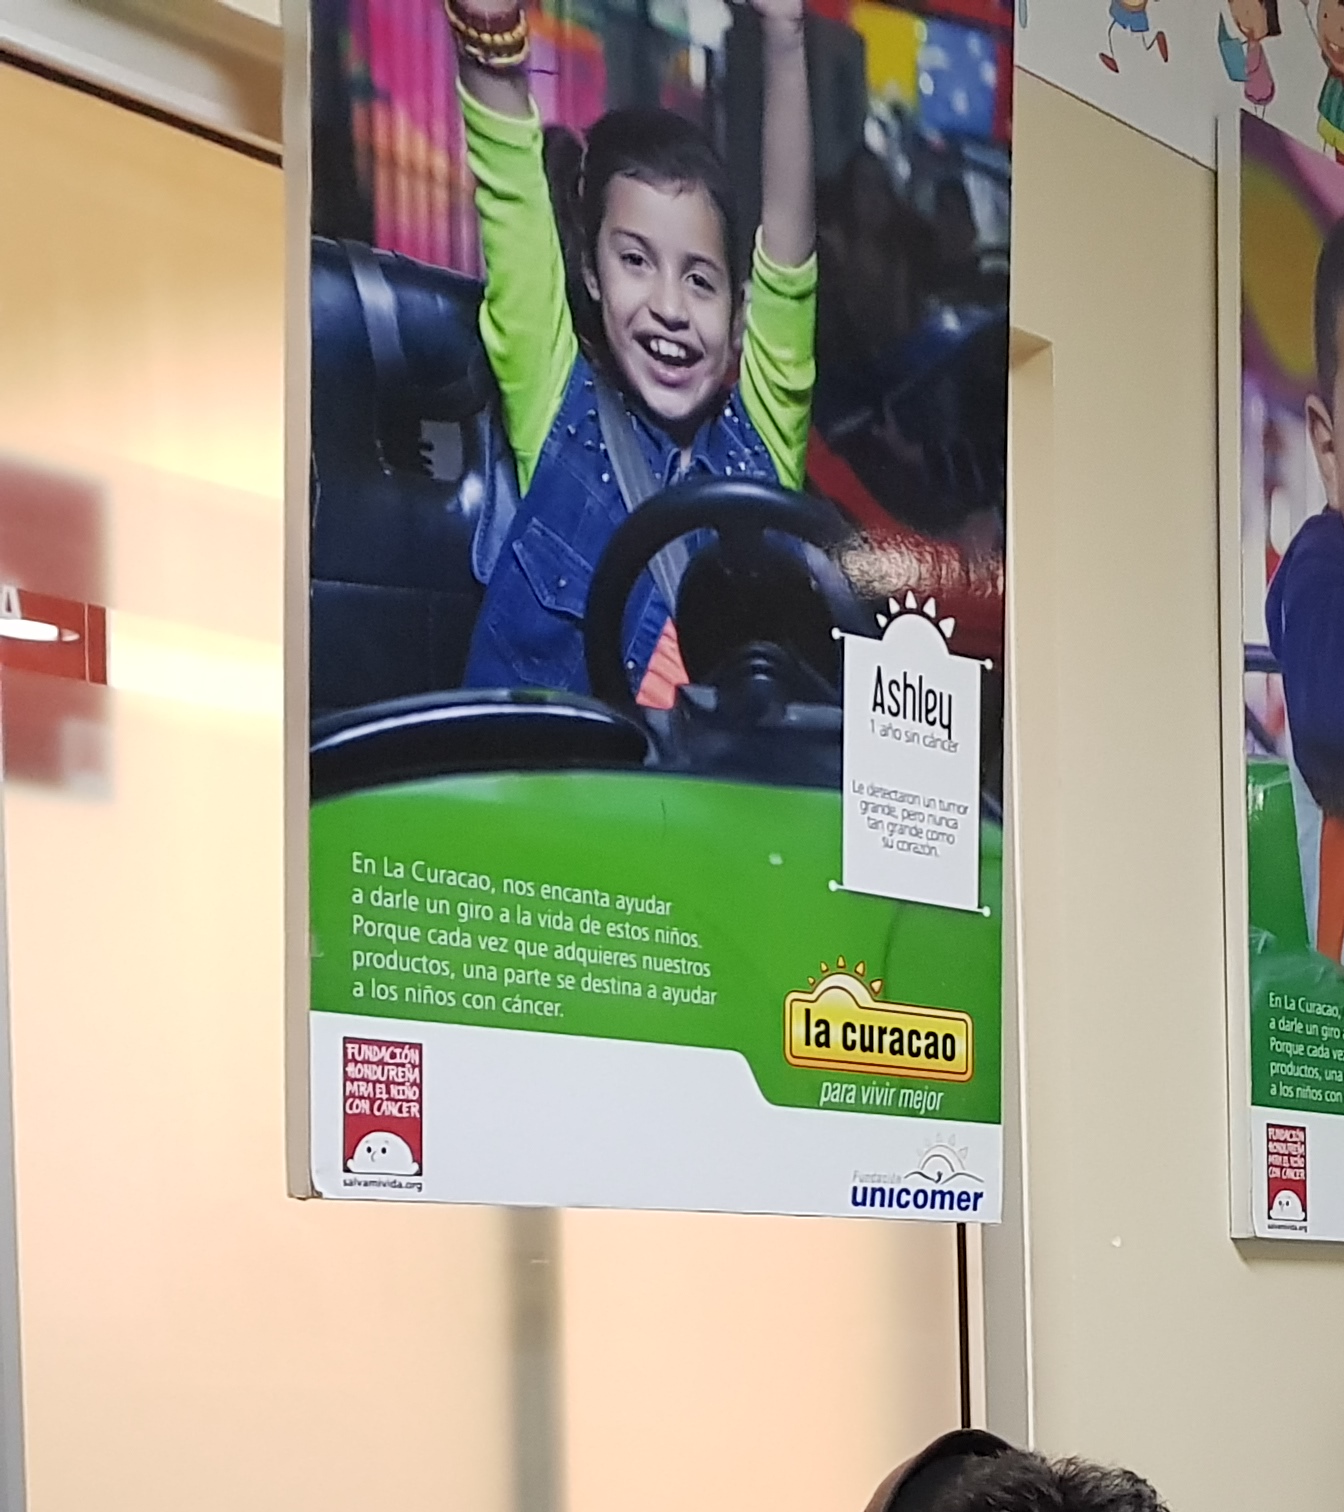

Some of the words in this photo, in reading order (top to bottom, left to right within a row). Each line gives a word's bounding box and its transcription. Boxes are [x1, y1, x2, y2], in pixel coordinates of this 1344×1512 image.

[872, 665, 952, 740] Ashley
[871, 719, 875, 734] 1
[880, 722, 901, 740] año
[905, 729, 919, 744] sin
[923, 733, 959, 753] cáncer
[352, 852, 375, 874] En
[384, 856, 404, 878] La
[412, 860, 496, 894] Curacao,
[503, 877, 534, 897] nos
[541, 881, 609, 907] encanta
[616, 892, 671, 917] ayudar
[352, 887, 363, 903] a
[371, 886, 419, 911] darle
[426, 899, 450, 914] un
[457, 898, 493, 922] giro
[500, 907, 510, 922] a
[517, 905, 532, 925] la
[538, 909, 574, 931] vida
[580, 916, 600, 935] de
[606, 922, 649, 942] estos
[655, 928, 702, 949] niños.
[352, 915, 420, 943] Porque
[428, 926, 471, 948] cada
[478, 934, 509, 952] vez
[515, 939, 548, 959] que
[554, 942, 637, 969] adquieres
[642, 954, 711, 978] nuestros
[352, 949, 455, 979] productos,
[463, 961, 497, 981] una
[504, 965, 550, 987] parte
[557, 974, 575, 989] se
[581, 973, 642, 997] destina
[648, 984, 657, 999] a
[662, 985, 717, 1006] ayudar
[352, 980, 363, 997] a
[371, 979, 398, 1001] los
[405, 985, 456, 1006] niños
[462, 991, 495, 1010] con
[502, 994, 564, 1018] cáncer.
[1270, 992, 1281, 1008] En
[1285, 995, 1295, 1011] La
[1298, 998, 1341, 1019] Curacao,
[805, 1008, 830, 1048] la
[842, 1022, 956, 1062] curacao
[1269, 1017, 1275, 1029] a
[1279, 1016, 1303, 1033] darle
[1306, 1024, 1318, 1036] un
[1322, 1024, 1340, 1041] giro
[346, 1043, 419, 1065] FUNDACIÓN
[1270, 1038, 1304, 1056] Porque
[1307, 1045, 1330, 1059] cada
[345, 1062, 419, 1083] HONDUREÑA
[1270, 1061, 1322, 1081] productos,
[1325, 1069, 1343, 1082] una
[376, 1083, 388, 1099] EL
[390, 1082, 419, 1100] NIÑO
[820, 1081, 857, 1107] para
[861, 1081, 895, 1106] vivir
[899, 1085, 943, 1114] mejor
[345, 1098, 370, 1115] CON
[851, 1186, 984, 1211] unicomer
